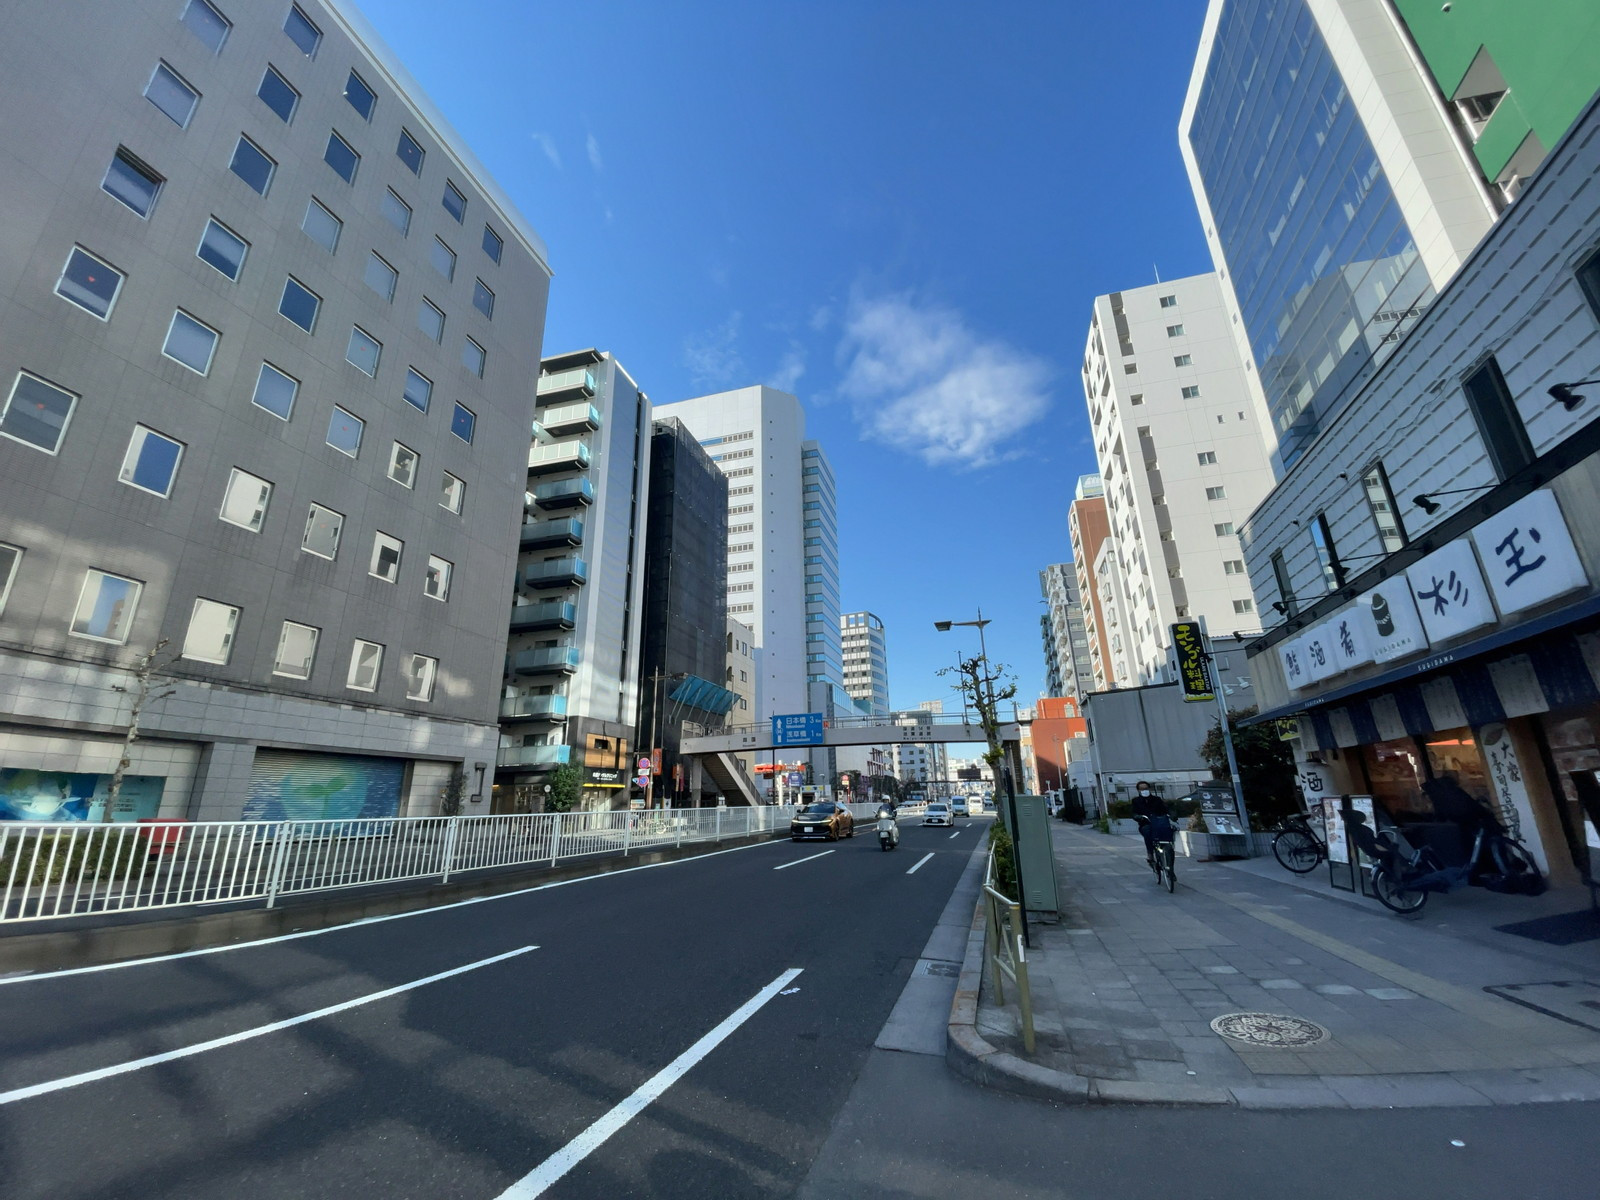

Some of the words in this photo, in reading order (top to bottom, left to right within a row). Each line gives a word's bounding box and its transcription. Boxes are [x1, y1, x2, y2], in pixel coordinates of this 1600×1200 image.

[1417, 527, 1546, 616] 杉玉
[1374, 637, 1412, 656] SUGIDAMA
[1176, 625, 1206, 691] モンゴル料理
[1417, 654, 1454, 671] SUGIDAMA
[786, 716, 806, 725] 日本橋
[809, 715, 815, 724] 3
